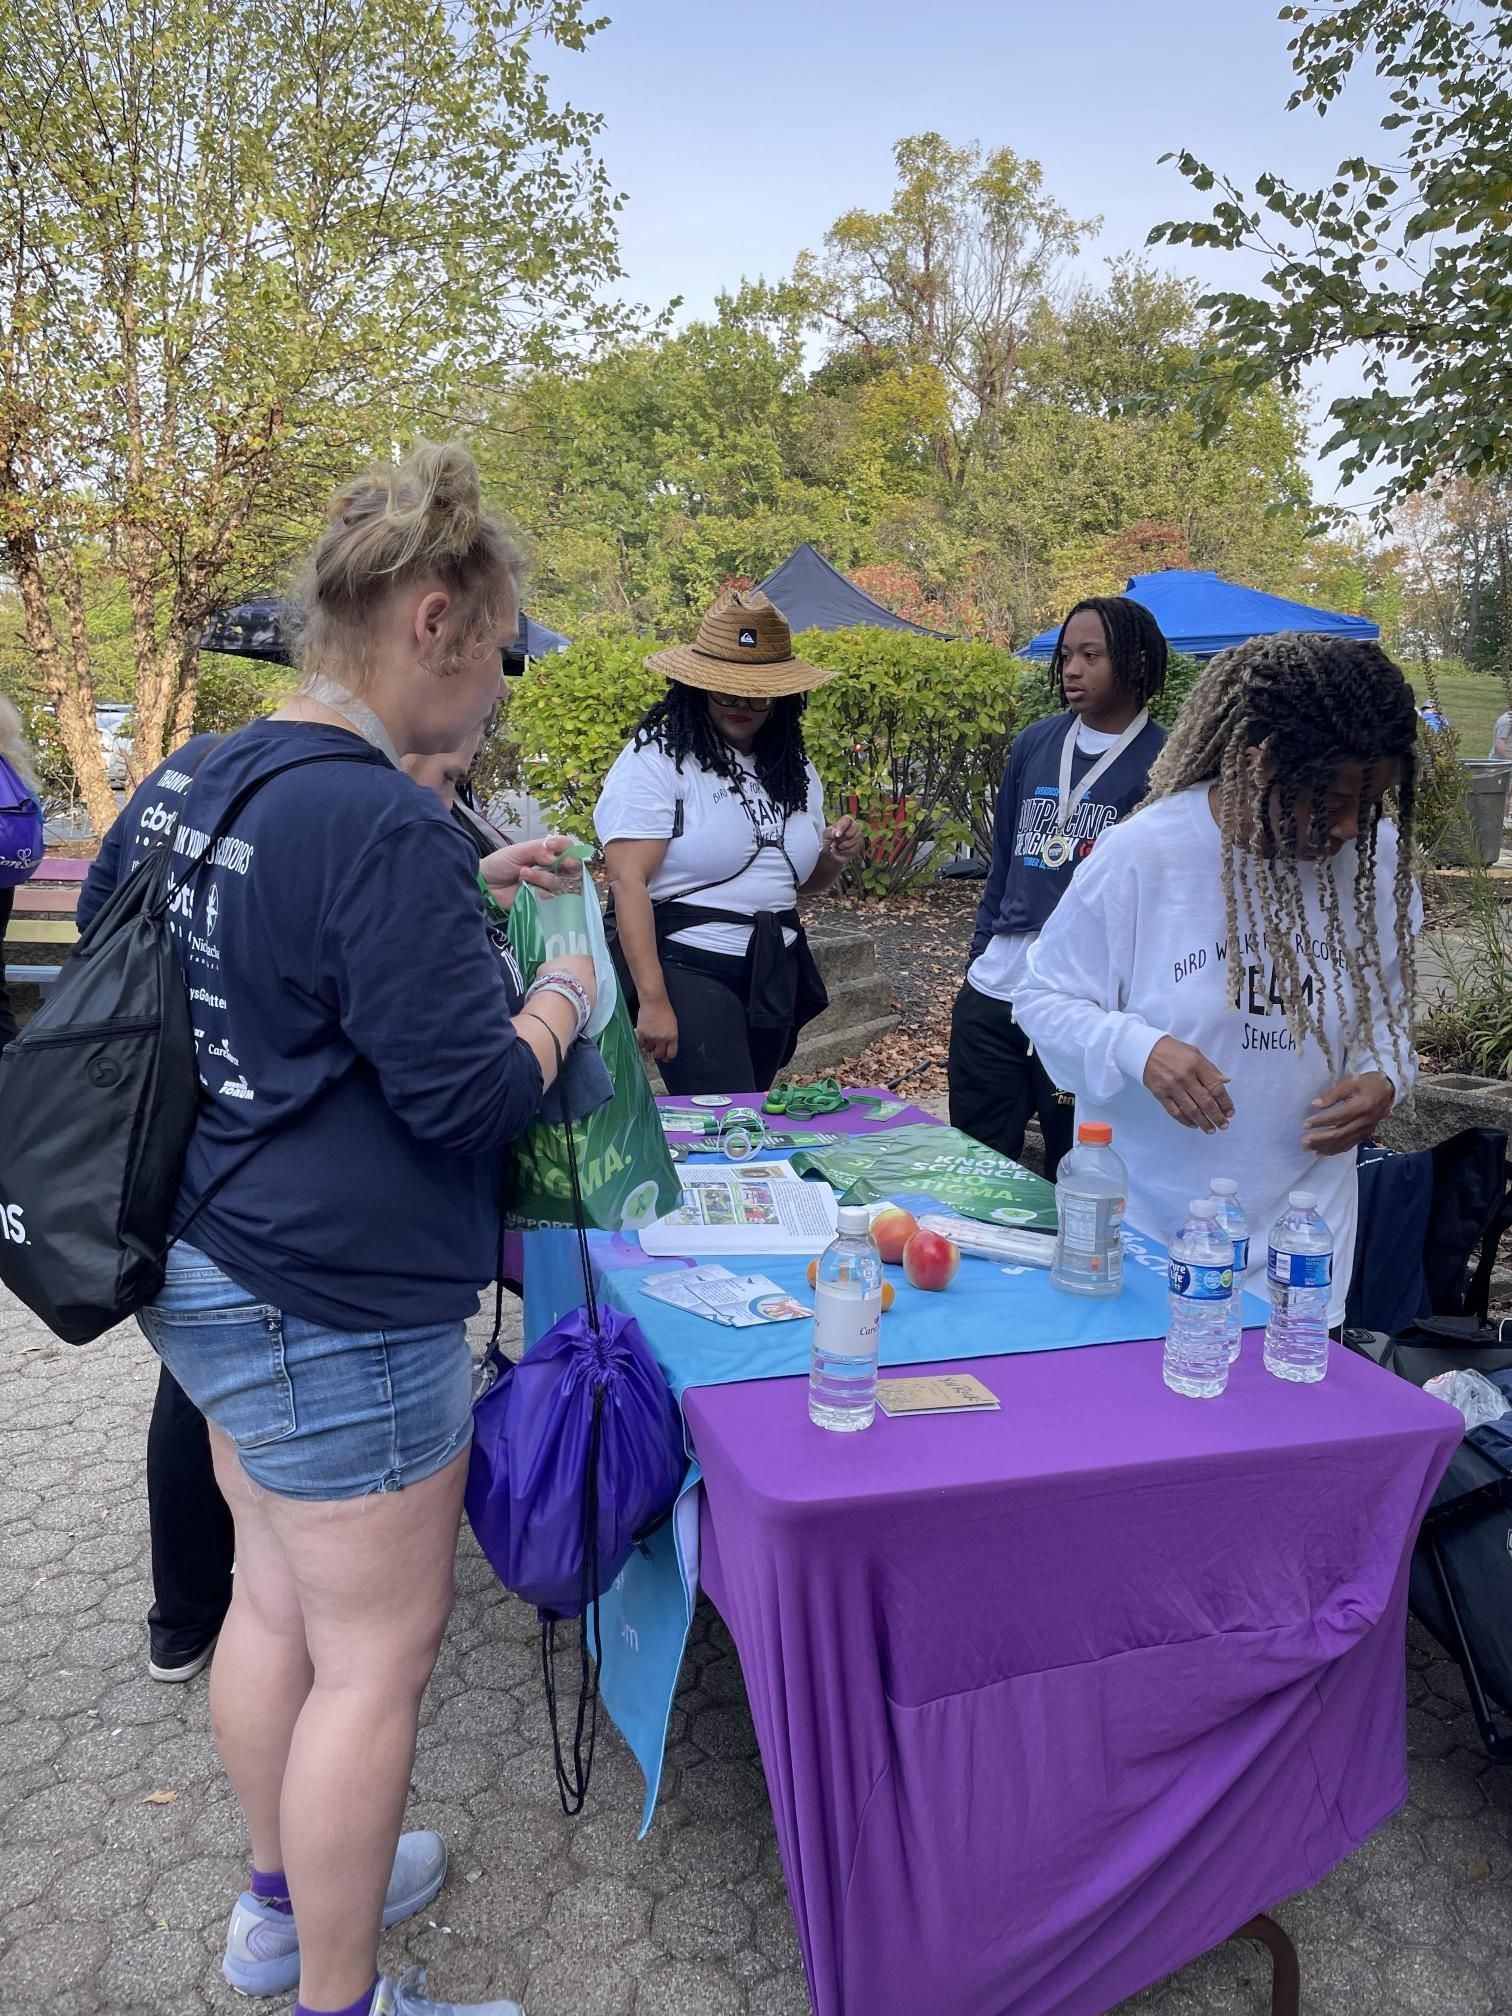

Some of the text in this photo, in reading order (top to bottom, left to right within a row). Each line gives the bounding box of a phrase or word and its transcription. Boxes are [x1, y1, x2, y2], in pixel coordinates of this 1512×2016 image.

[1174, 949, 1207, 983] BIRD
[1215, 933, 1254, 961] WLK
[910, 1161, 1037, 1182] SCIENCE.
[933, 1155, 1024, 1170] KNOW
[900, 1178, 1023, 1202] STIGMA.
[942, 1172, 986, 1187] NO
